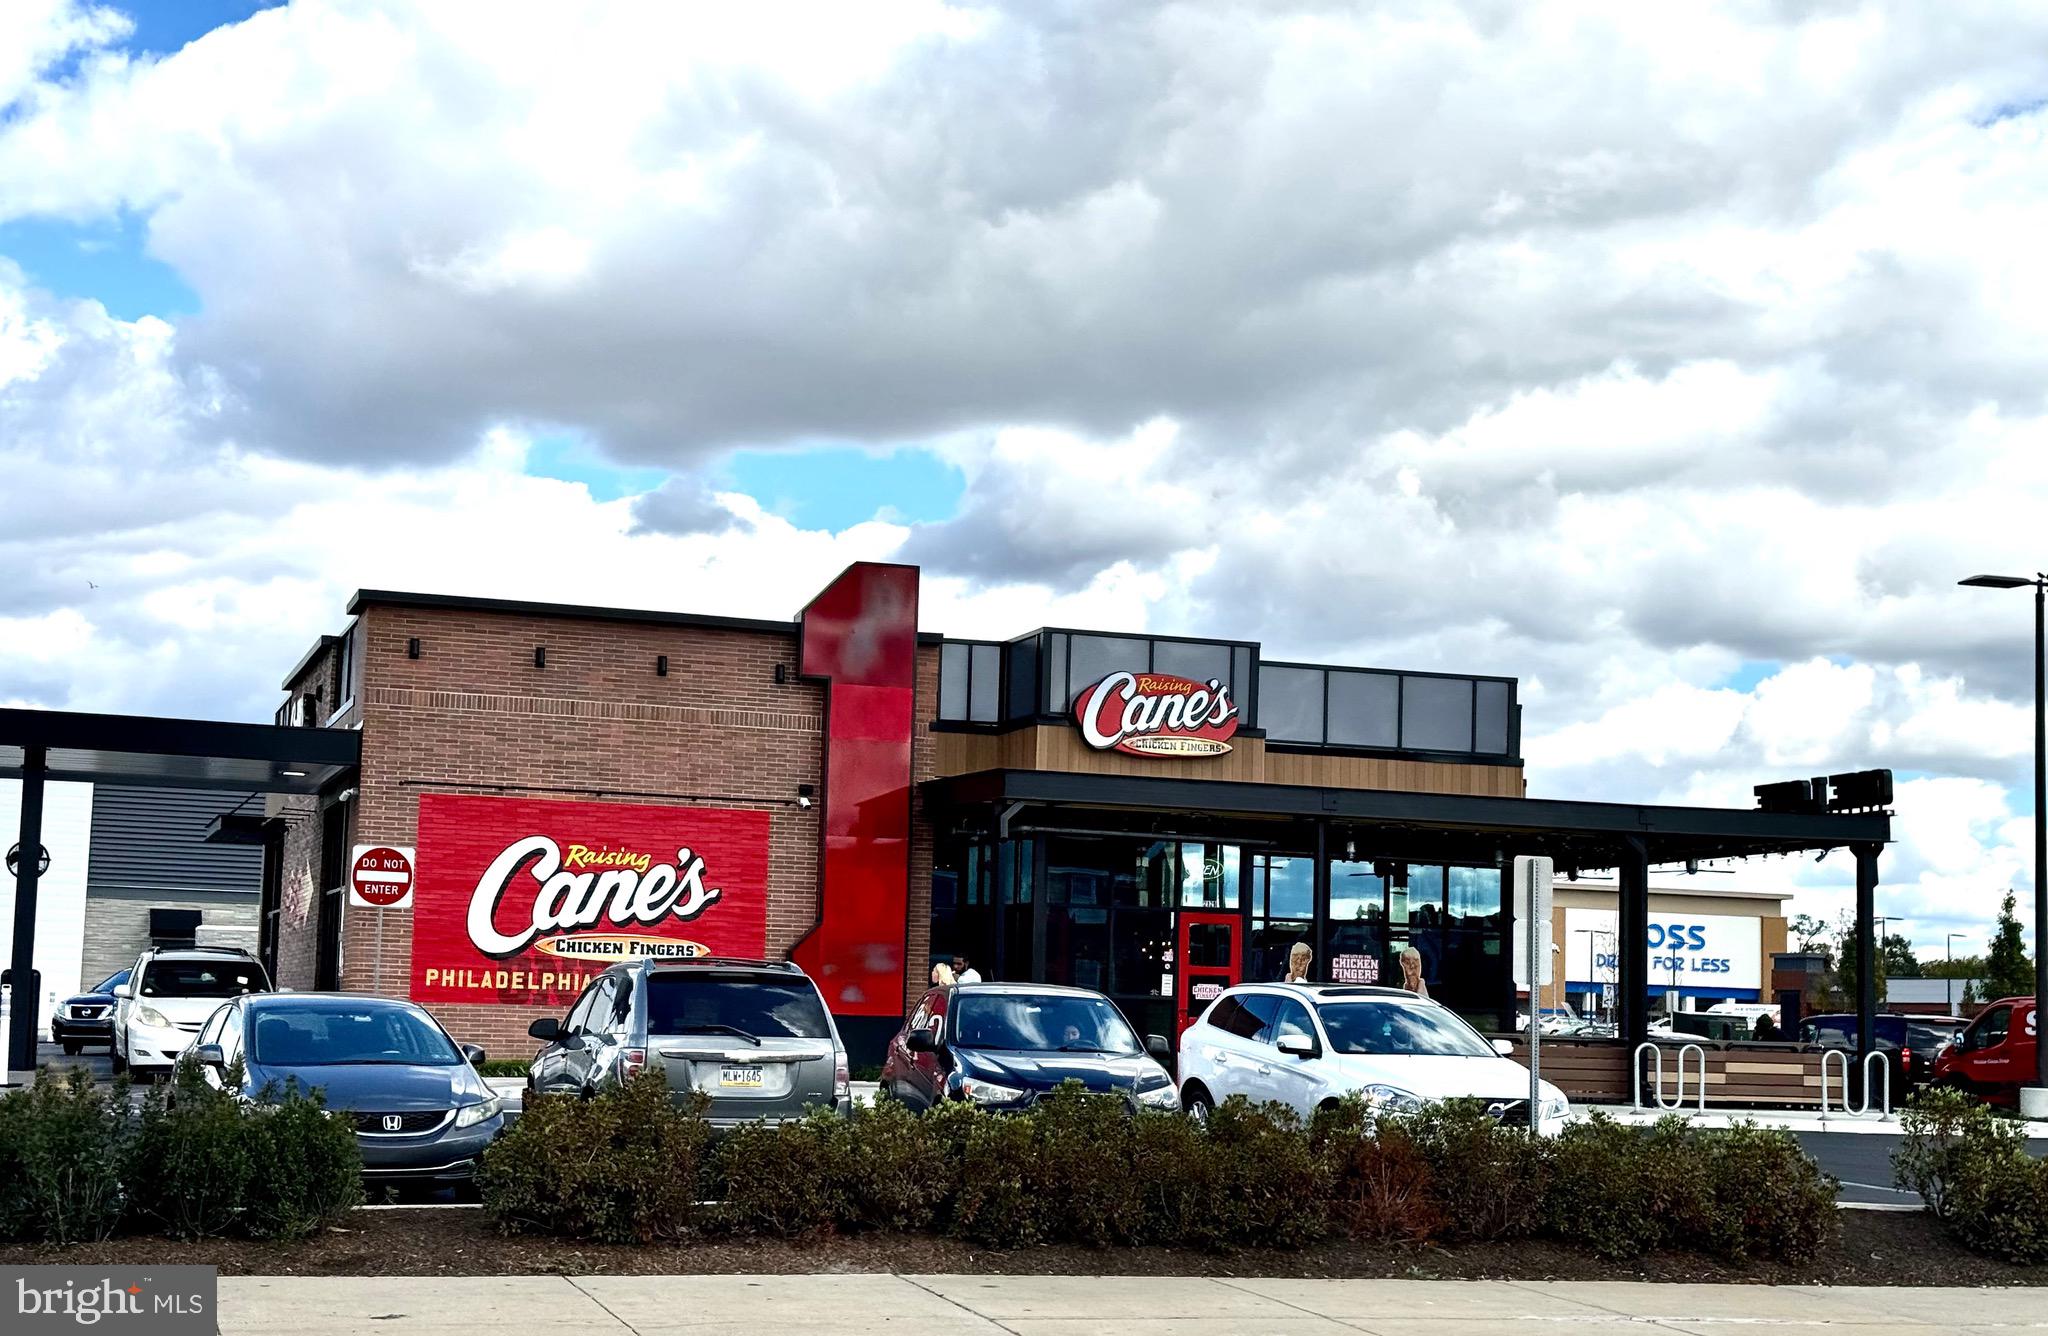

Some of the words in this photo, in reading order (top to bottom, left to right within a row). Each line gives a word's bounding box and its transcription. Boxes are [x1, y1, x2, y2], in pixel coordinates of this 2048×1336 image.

[1138, 677, 1192, 695] Raising
[1082, 671, 1238, 749] Cane's
[1135, 738, 1177, 750] CHICKEN
[1180, 741, 1222, 753] FINGERS
[362, 857, 377, 868] DO
[383, 859, 405, 869] NOT
[564, 844, 652, 873] Raising
[364, 884, 399, 895] ENTER
[466, 835, 722, 957] Cane's
[1647, 923, 1706, 951] OSS
[555, 938, 624, 954] CHICKEN
[629, 941, 694, 957] FINGERS
[1332, 958, 1379, 970] CHICKEN
[1653, 956, 1685, 971] FOR
[1691, 958, 1731, 973] LESS
[1331, 969, 1379, 980] FINGERS
